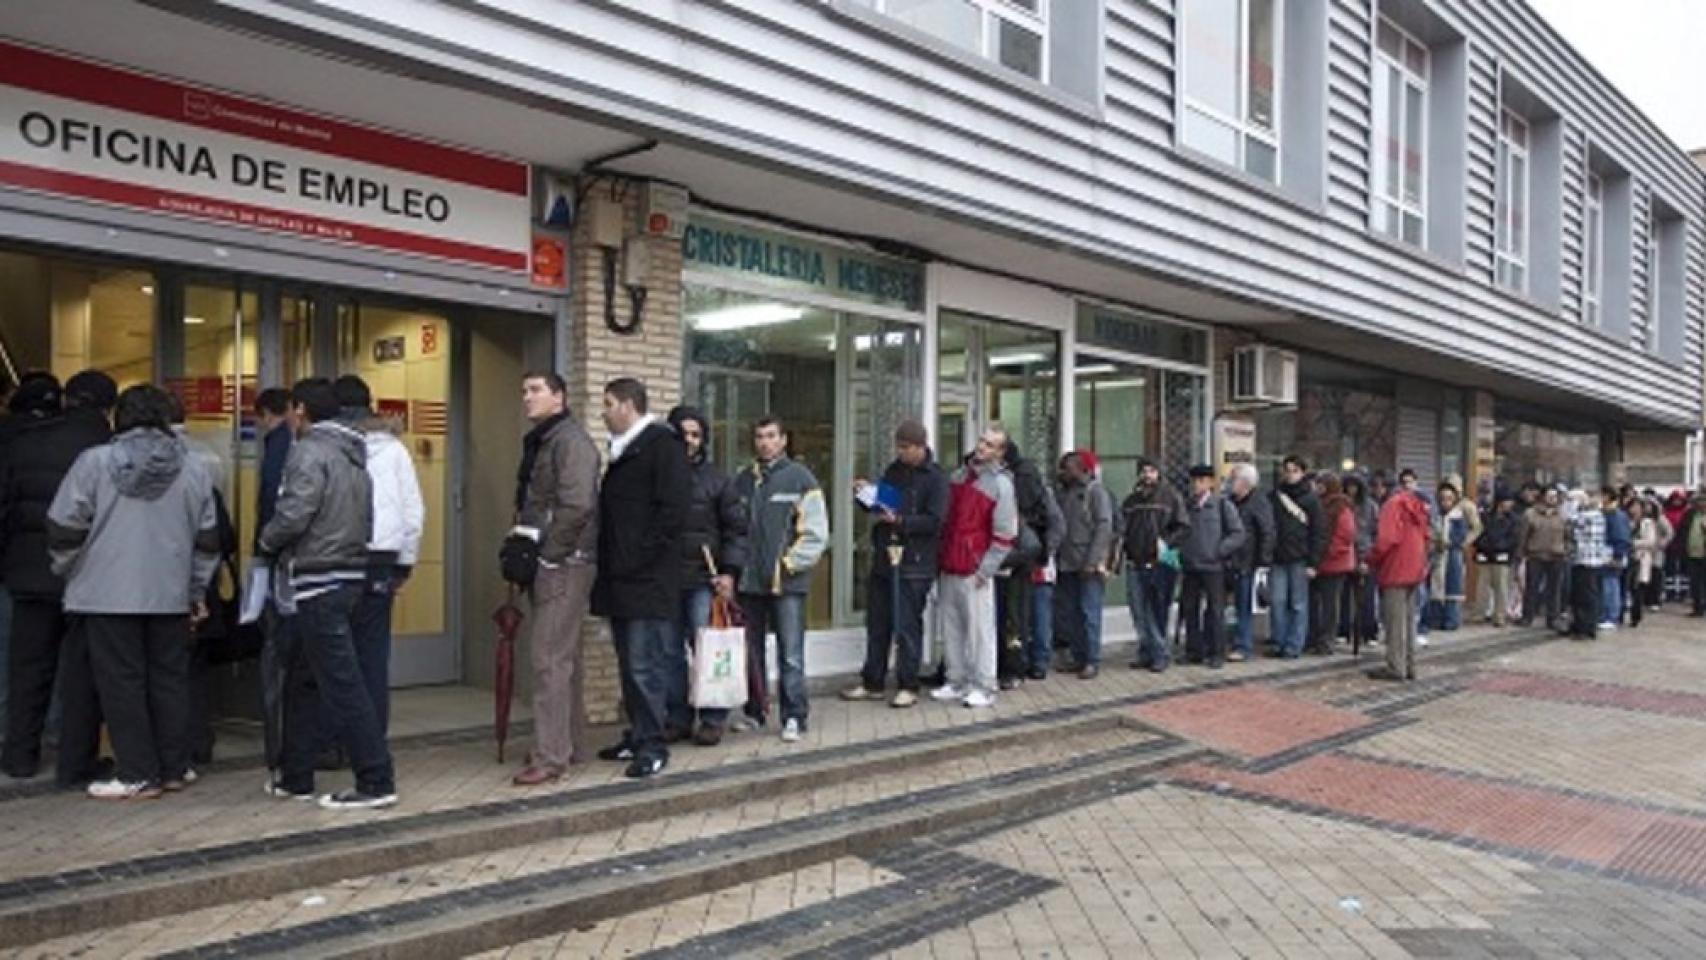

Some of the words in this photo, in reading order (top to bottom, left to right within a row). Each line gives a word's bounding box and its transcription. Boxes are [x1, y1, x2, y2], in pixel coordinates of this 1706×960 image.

[18, 110, 218, 180] OFICINA
[231, 153, 287, 194] DE
[299, 167, 451, 223] EMPLEO
